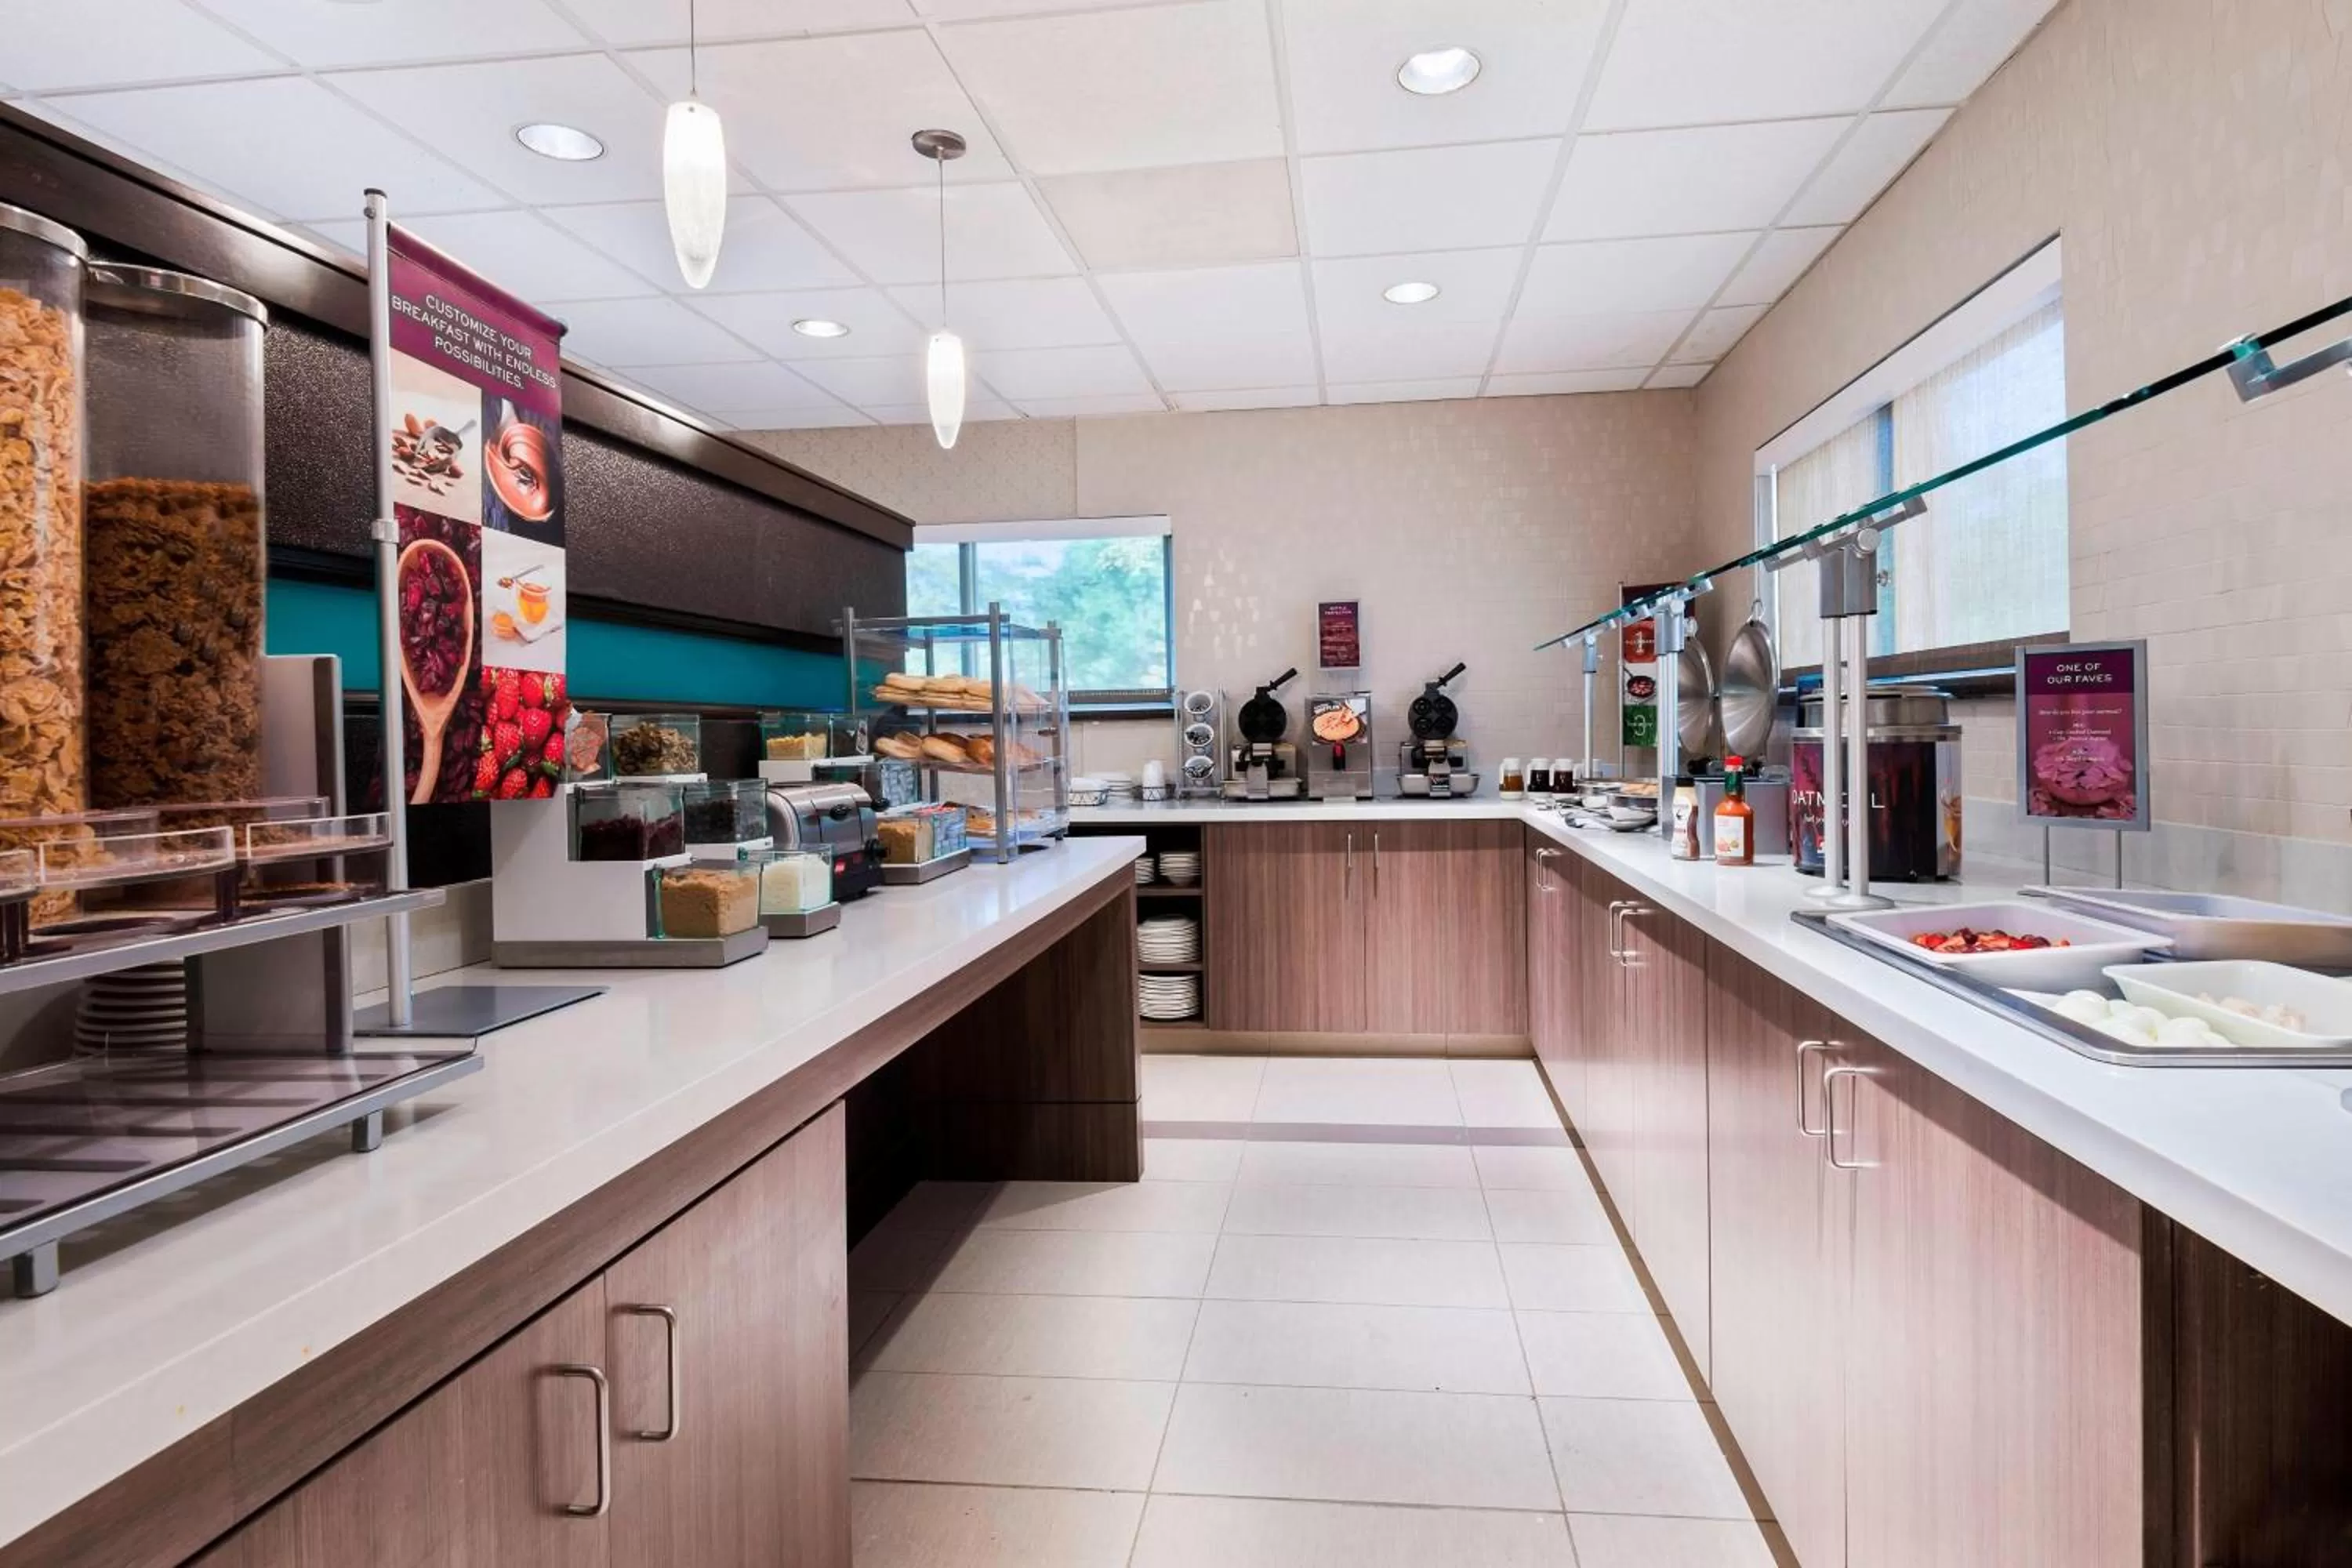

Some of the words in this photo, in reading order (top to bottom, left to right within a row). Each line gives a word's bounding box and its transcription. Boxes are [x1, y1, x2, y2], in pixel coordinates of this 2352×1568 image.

[392, 296, 470, 343] BREAKFAST
[473, 338, 503, 361] WITH
[506, 355, 556, 388] ENDLESS
[426, 295, 497, 343] CUSTOMIZE
[500, 333, 532, 359] YOUR
[2047, 675, 2071, 684] OUR
[2075, 673, 2113, 683] FAVES
[2085, 662, 2102, 671] OF
